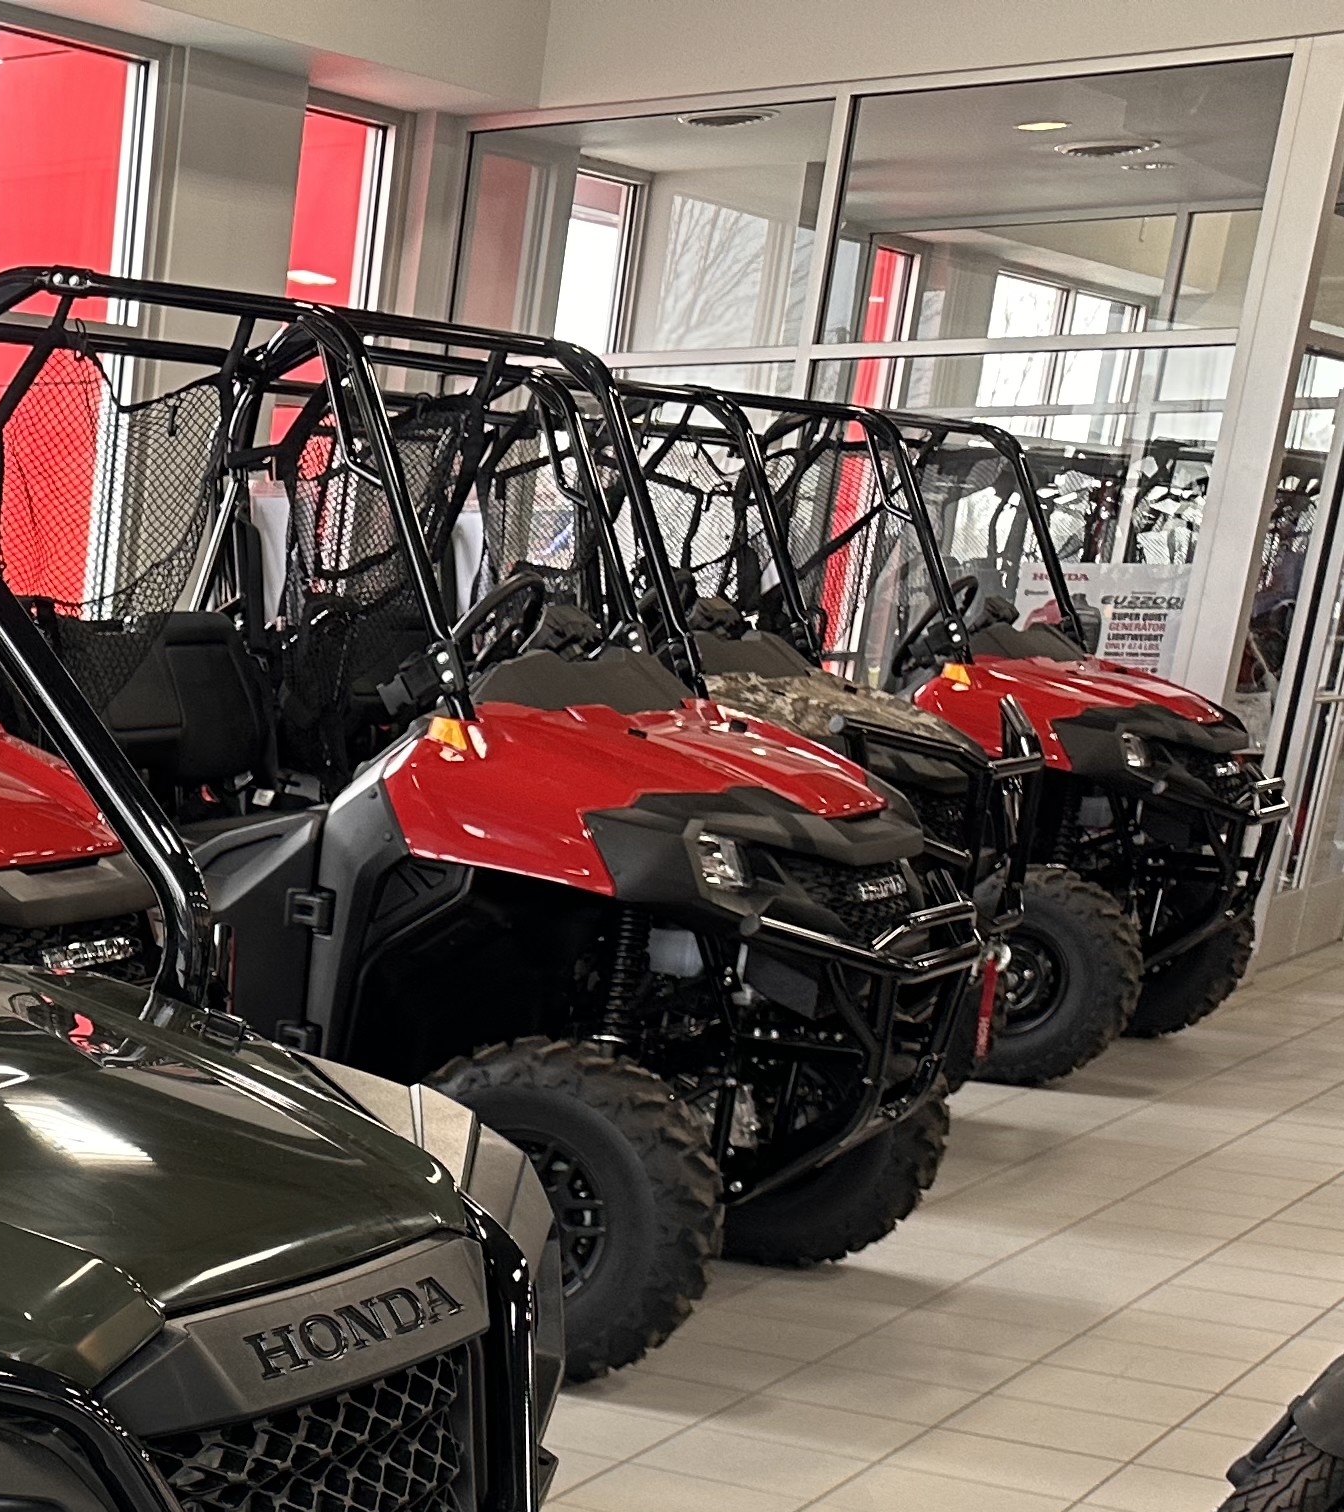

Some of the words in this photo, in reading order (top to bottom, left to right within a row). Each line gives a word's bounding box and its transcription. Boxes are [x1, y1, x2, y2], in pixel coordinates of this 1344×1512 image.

[1032, 572, 1090, 582] HDA
[1108, 622, 1167, 632] GENERATOR
[242, 1276, 465, 1380] HONDA
